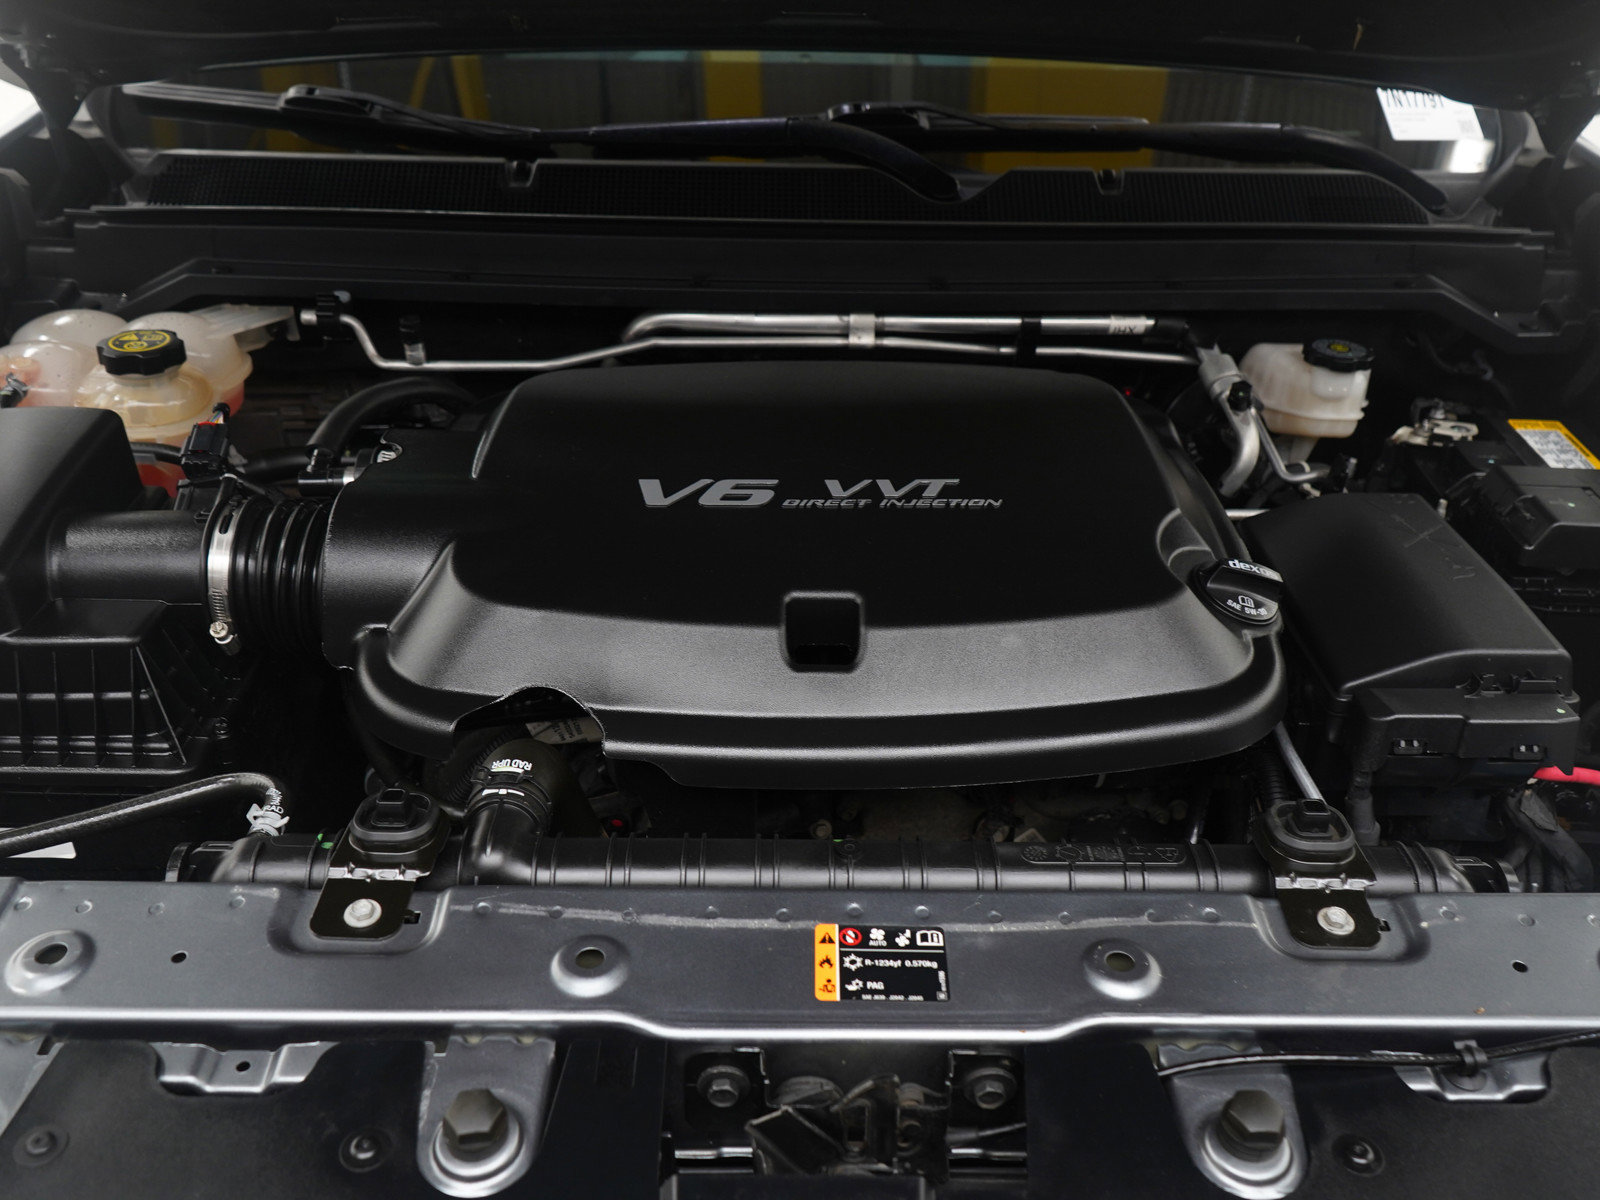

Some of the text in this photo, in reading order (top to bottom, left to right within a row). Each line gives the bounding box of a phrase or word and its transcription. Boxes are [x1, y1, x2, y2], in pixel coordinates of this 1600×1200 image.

[638, 478, 779, 508] V6
[824, 478, 960, 499] VVT
[781, 498, 1003, 509] DIRECT INJECTION
[1226, 599, 1242, 612] SAE
[511, 758, 533, 771] RAD
[866, 981, 885, 991] PAG
